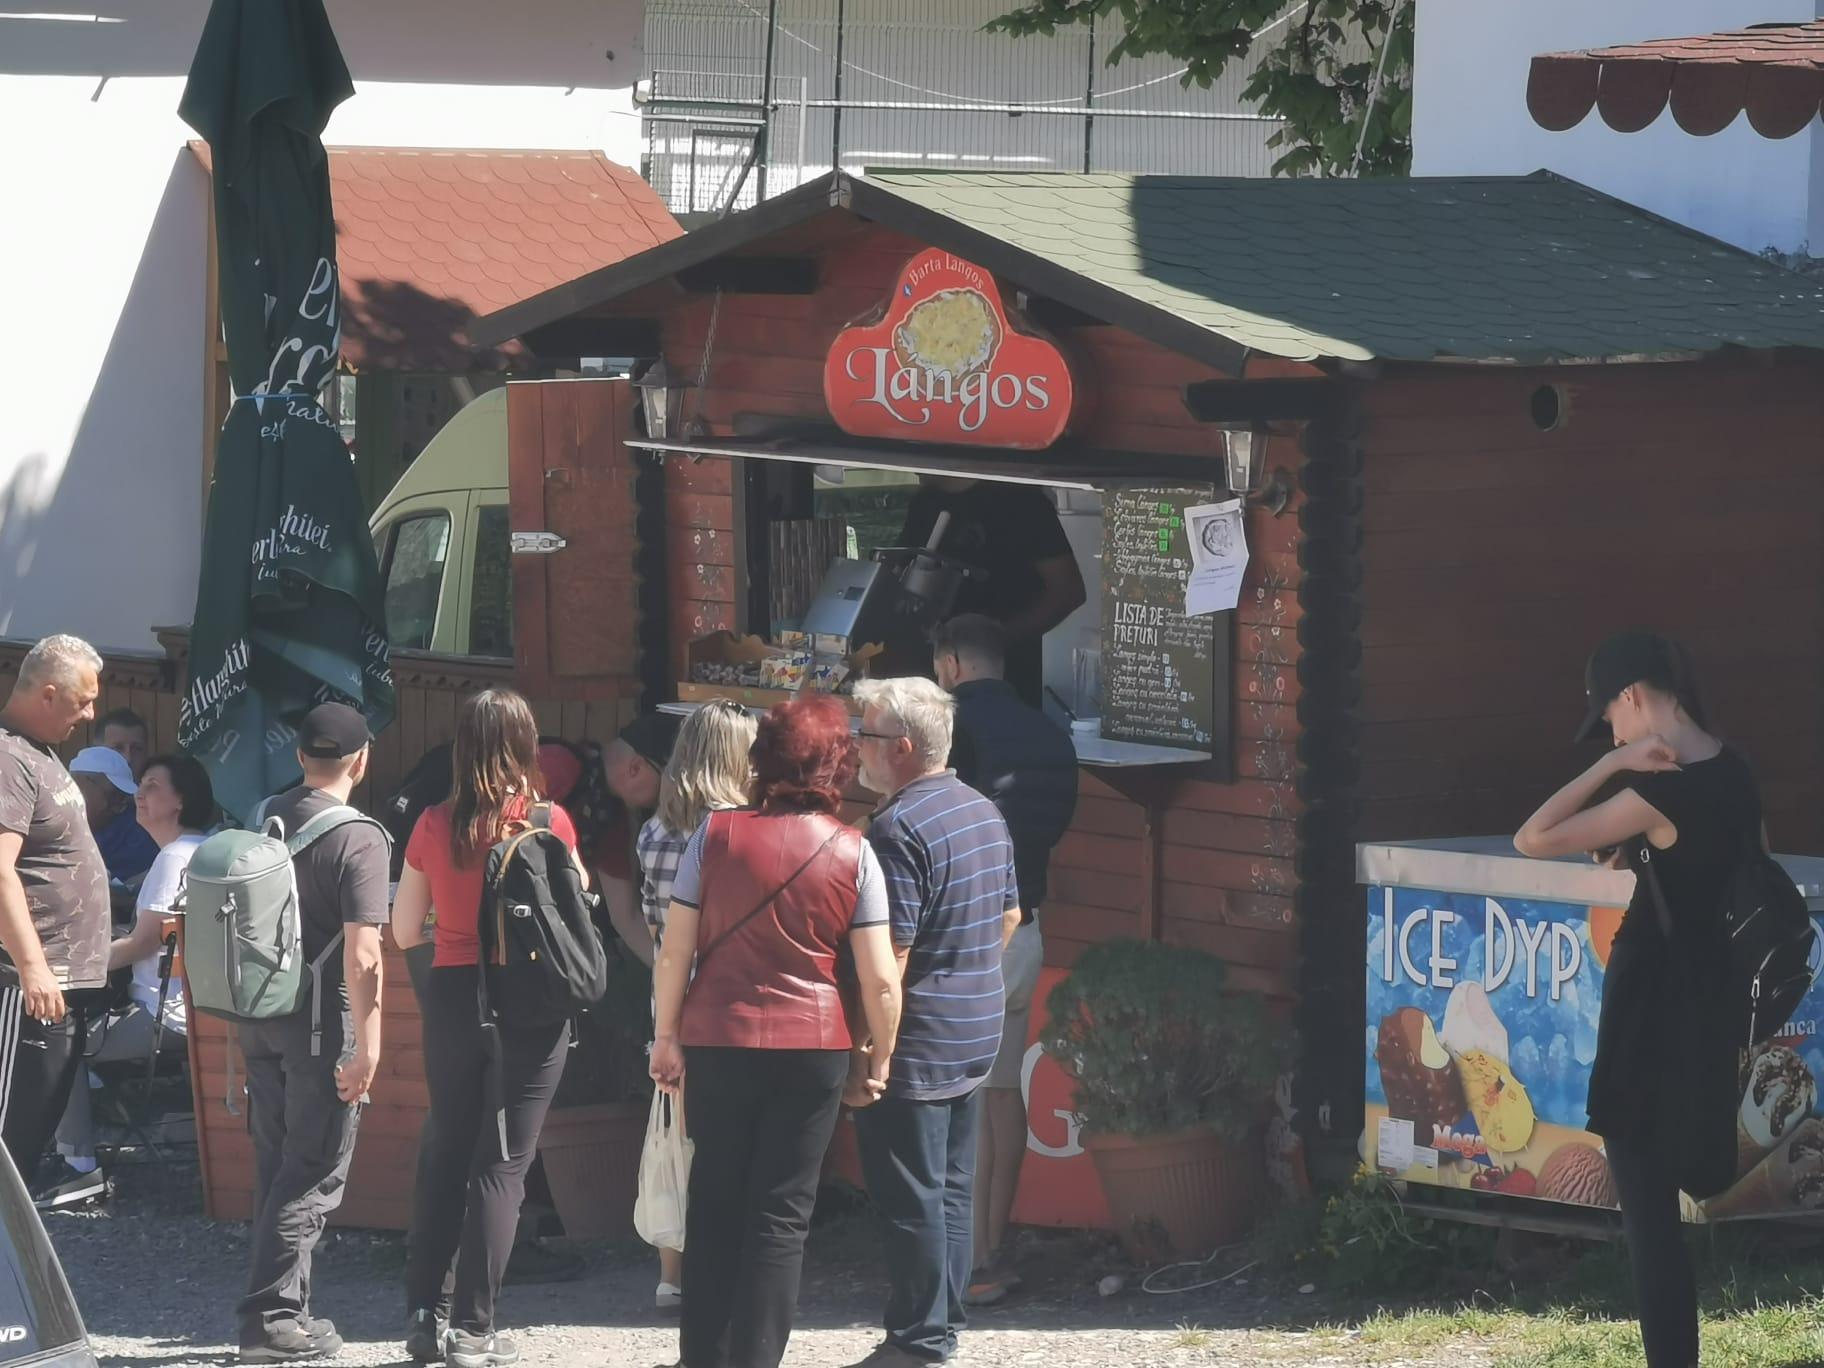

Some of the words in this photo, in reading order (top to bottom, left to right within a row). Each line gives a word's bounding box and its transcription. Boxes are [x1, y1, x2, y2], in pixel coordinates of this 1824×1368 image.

[909, 258, 941, 286] Barta
[1149, 606, 1164, 626] DE
[1384, 886, 1457, 989] ICE
[1485, 896, 1581, 1001] DYP
